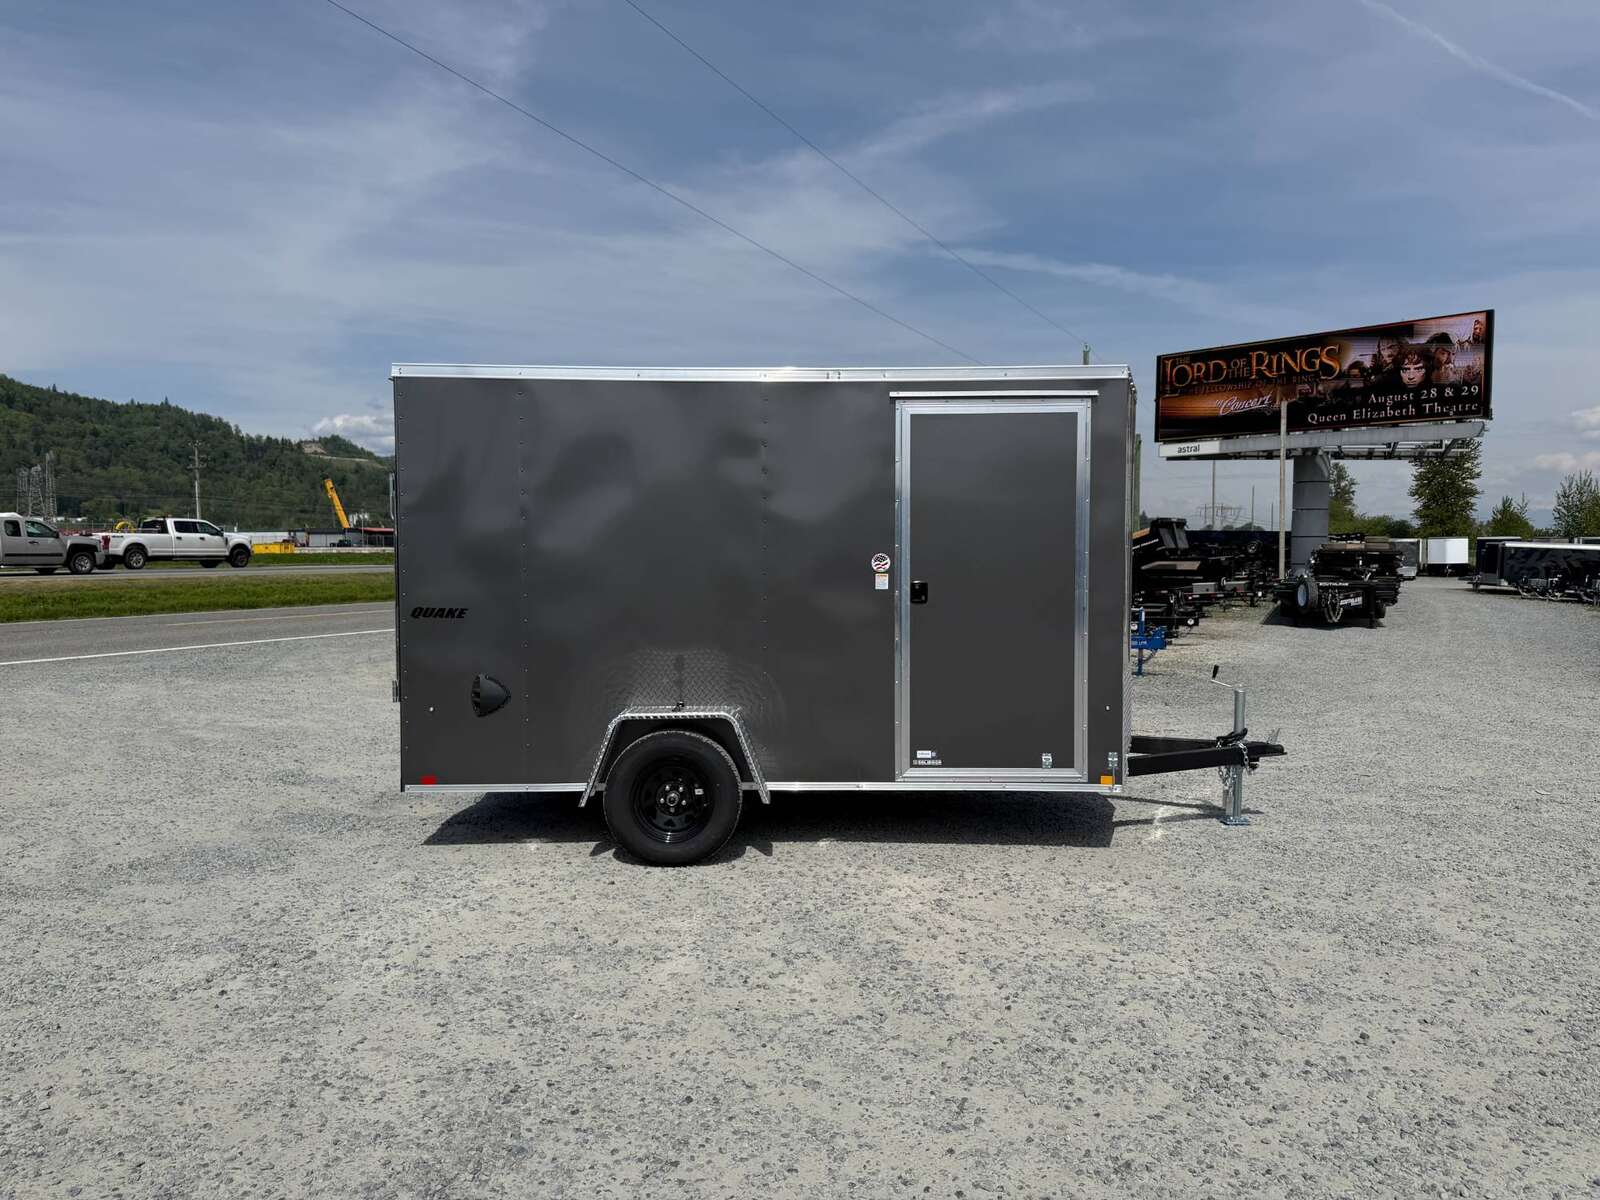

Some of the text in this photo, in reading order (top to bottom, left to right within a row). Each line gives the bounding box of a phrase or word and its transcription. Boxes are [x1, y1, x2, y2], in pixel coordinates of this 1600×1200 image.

[1227, 366, 1250, 379] THE
[1230, 358, 1247, 369] OF
[1249, 344, 1340, 380] RINGS
[1163, 358, 1227, 397] LORD
[1219, 389, 1272, 415] Concert
[1368, 385, 1479, 406] August 28 & 29
[1307, 402, 1479, 425] Queen Elizabeth Theatre
[1177, 444, 1201, 458] astral
[410, 606, 468, 618] QUAKE
